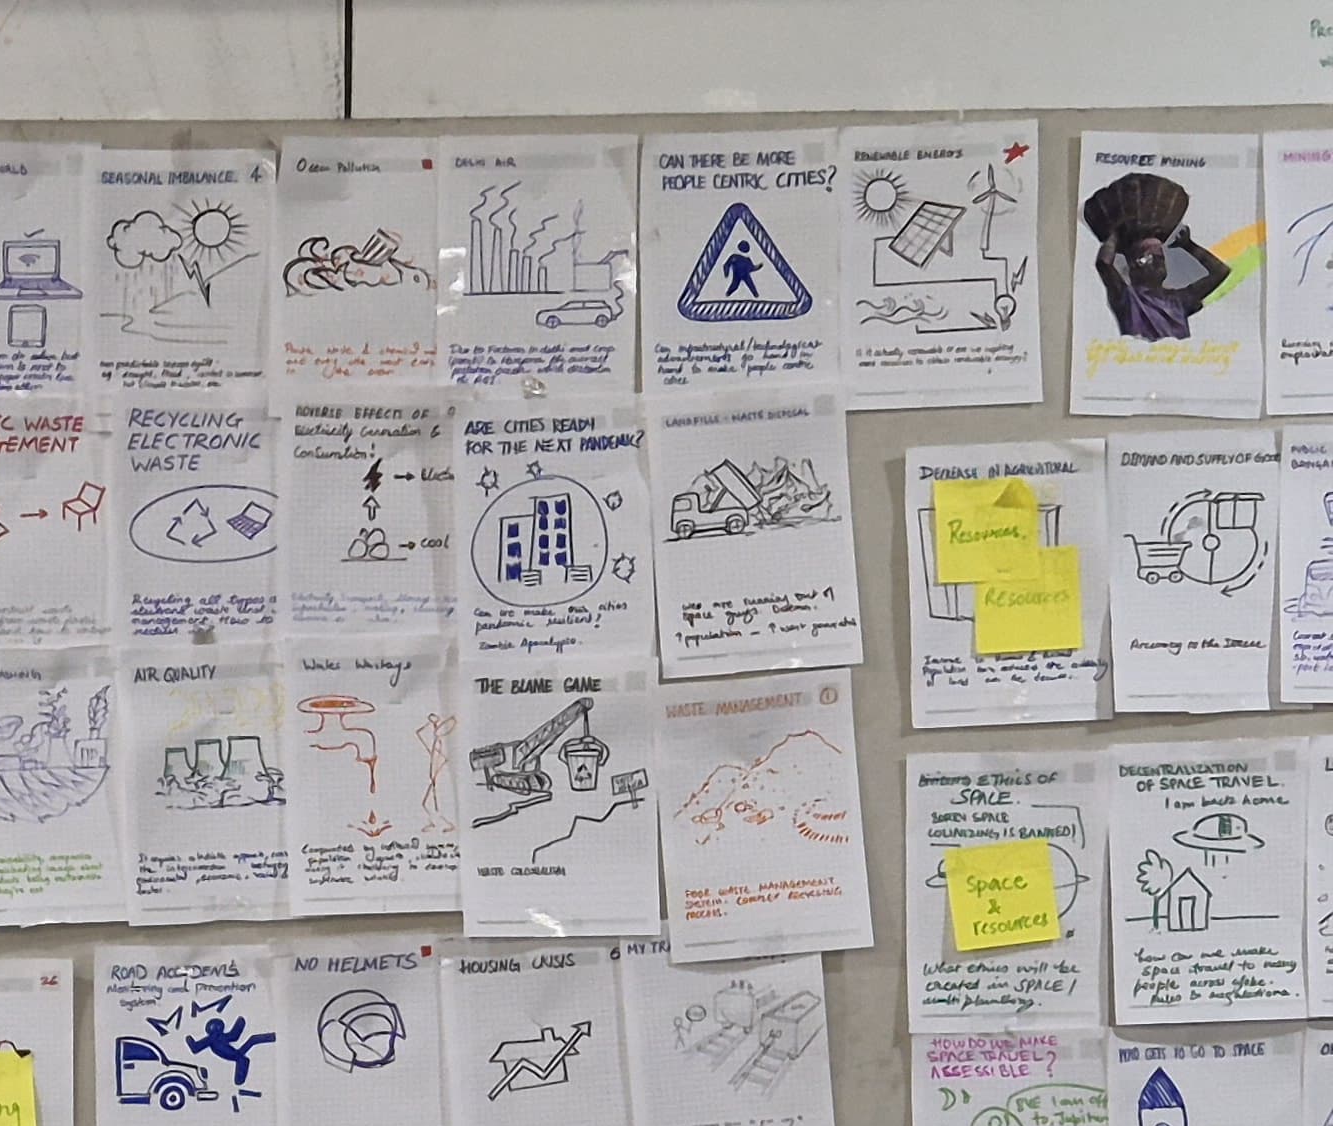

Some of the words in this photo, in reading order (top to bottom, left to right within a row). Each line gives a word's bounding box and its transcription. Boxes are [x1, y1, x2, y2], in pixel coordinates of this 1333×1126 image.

[658, 153, 685, 170] CAN
[688, 153, 726, 169] THERE
[732, 151, 750, 167] BE
[756, 150, 795, 167] MORE
[662, 174, 706, 191] PEOPLE
[712, 172, 768, 191] CENTRIC
[775, 164, 838, 193] CITIES?
[23, 415, 85, 433] WASTE
[127, 407, 244, 429] RECYCLING
[464, 420, 496, 436] ARE
[503, 417, 546, 434] CITIES
[552, 417, 596, 434] READY
[127, 431, 261, 451] ELECTRONIC
[465, 439, 494, 456] FOR
[497, 439, 527, 456] THE
[534, 438, 572, 453] NEXT
[131, 453, 201, 473] WASTE
[133, 666, 161, 684] AIR
[163, 663, 217, 684] QUALITY
[474, 677, 505, 695] THE
[510, 677, 553, 695] BLAME
[563, 676, 602, 693] GAME
[1118, 762, 1249, 779] DECENTRALIZATION
[1136, 778, 1155, 793] OF
[1159, 776, 1206, 791] SPACE
[972, 912, 1049, 937] resources
[110, 963, 148, 982] ROAD
[294, 956, 319, 972] NO
[327, 952, 418, 974] HELMETS
[458, 958, 521, 975] HOUSING
